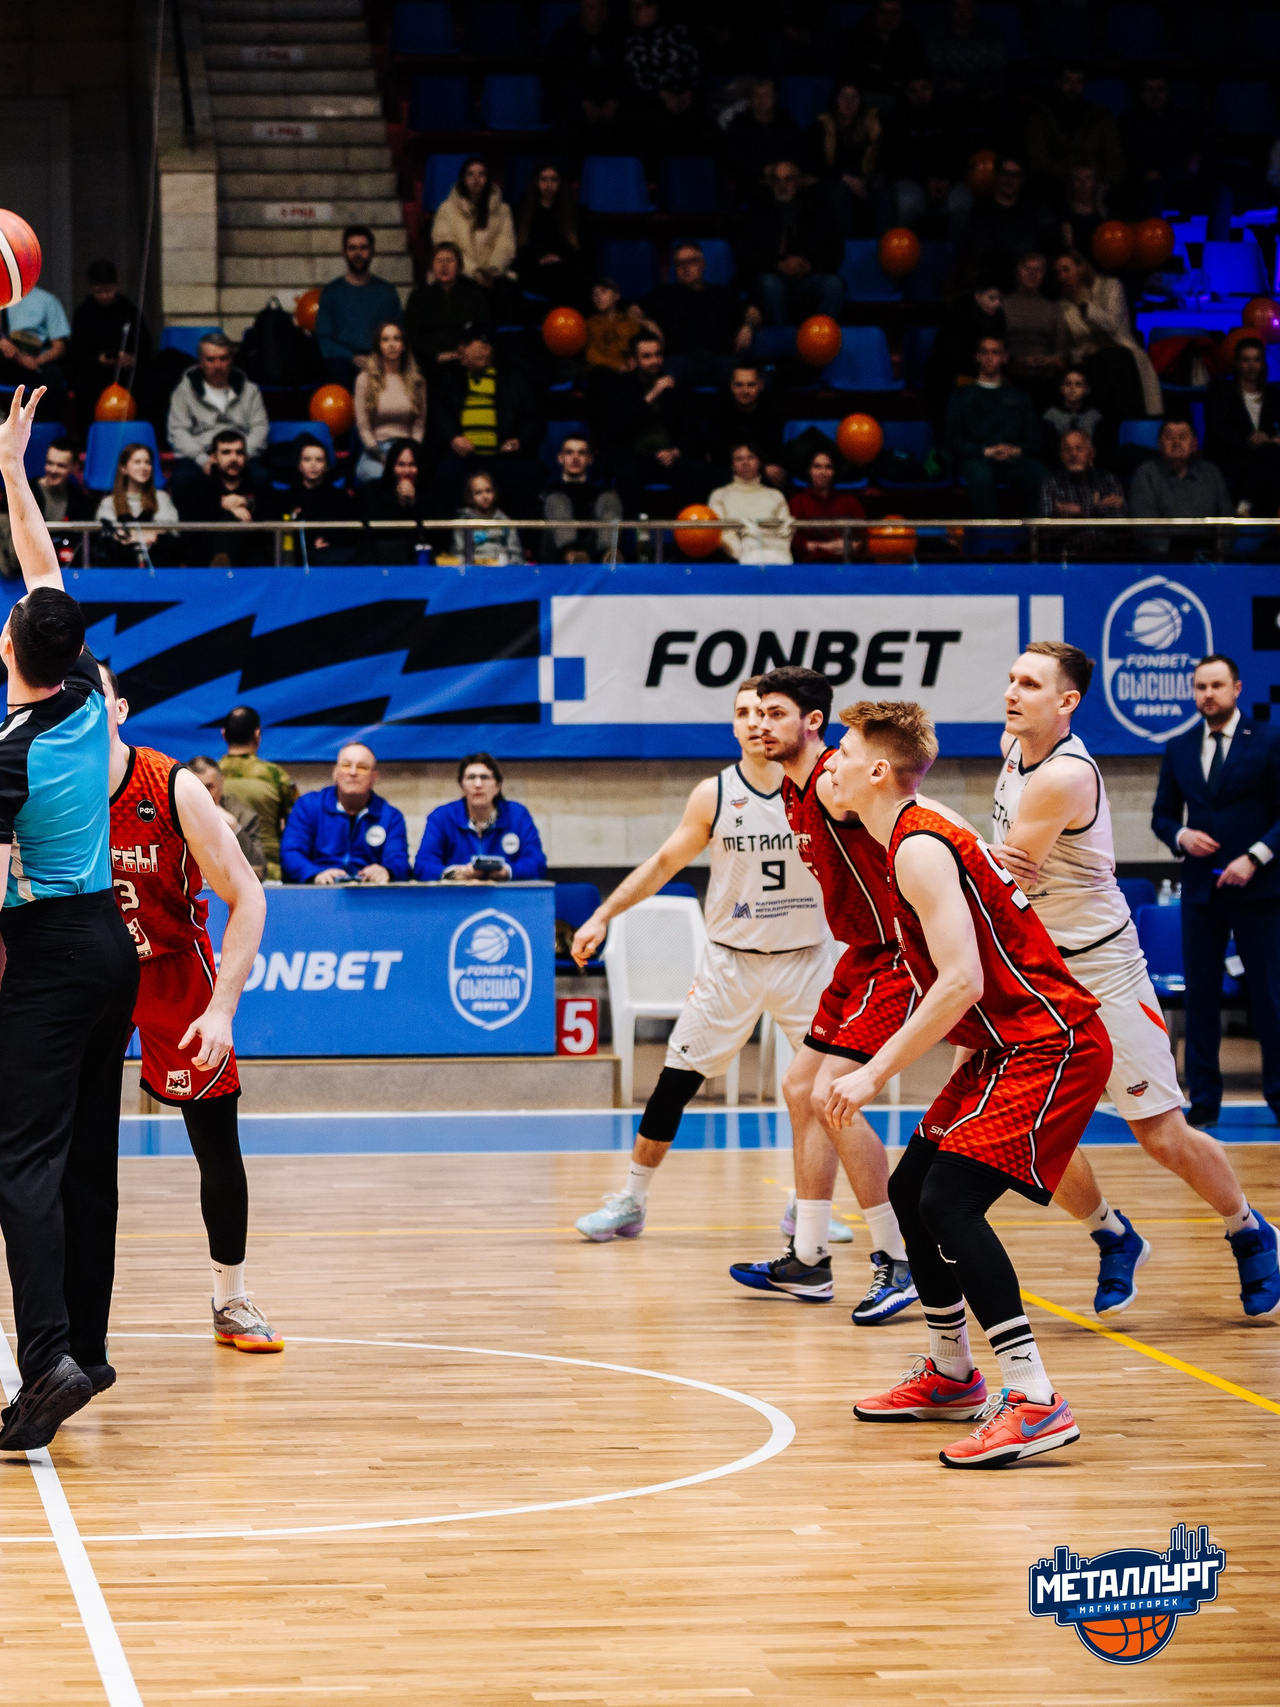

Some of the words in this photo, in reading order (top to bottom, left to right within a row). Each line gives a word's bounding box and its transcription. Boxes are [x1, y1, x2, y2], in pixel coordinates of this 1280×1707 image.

[645, 629, 963, 688] FONBET
[1125, 653, 1190, 668] FONBET
[1133, 704, 1183, 717] ЛИГА
[723, 833, 796, 852] МЕТАЛЛ
[761, 860, 786, 892] 9
[240, 950, 403, 992] ONBET
[465, 964, 516, 977] FONBET
[563, 1001, 595, 1054] 5
